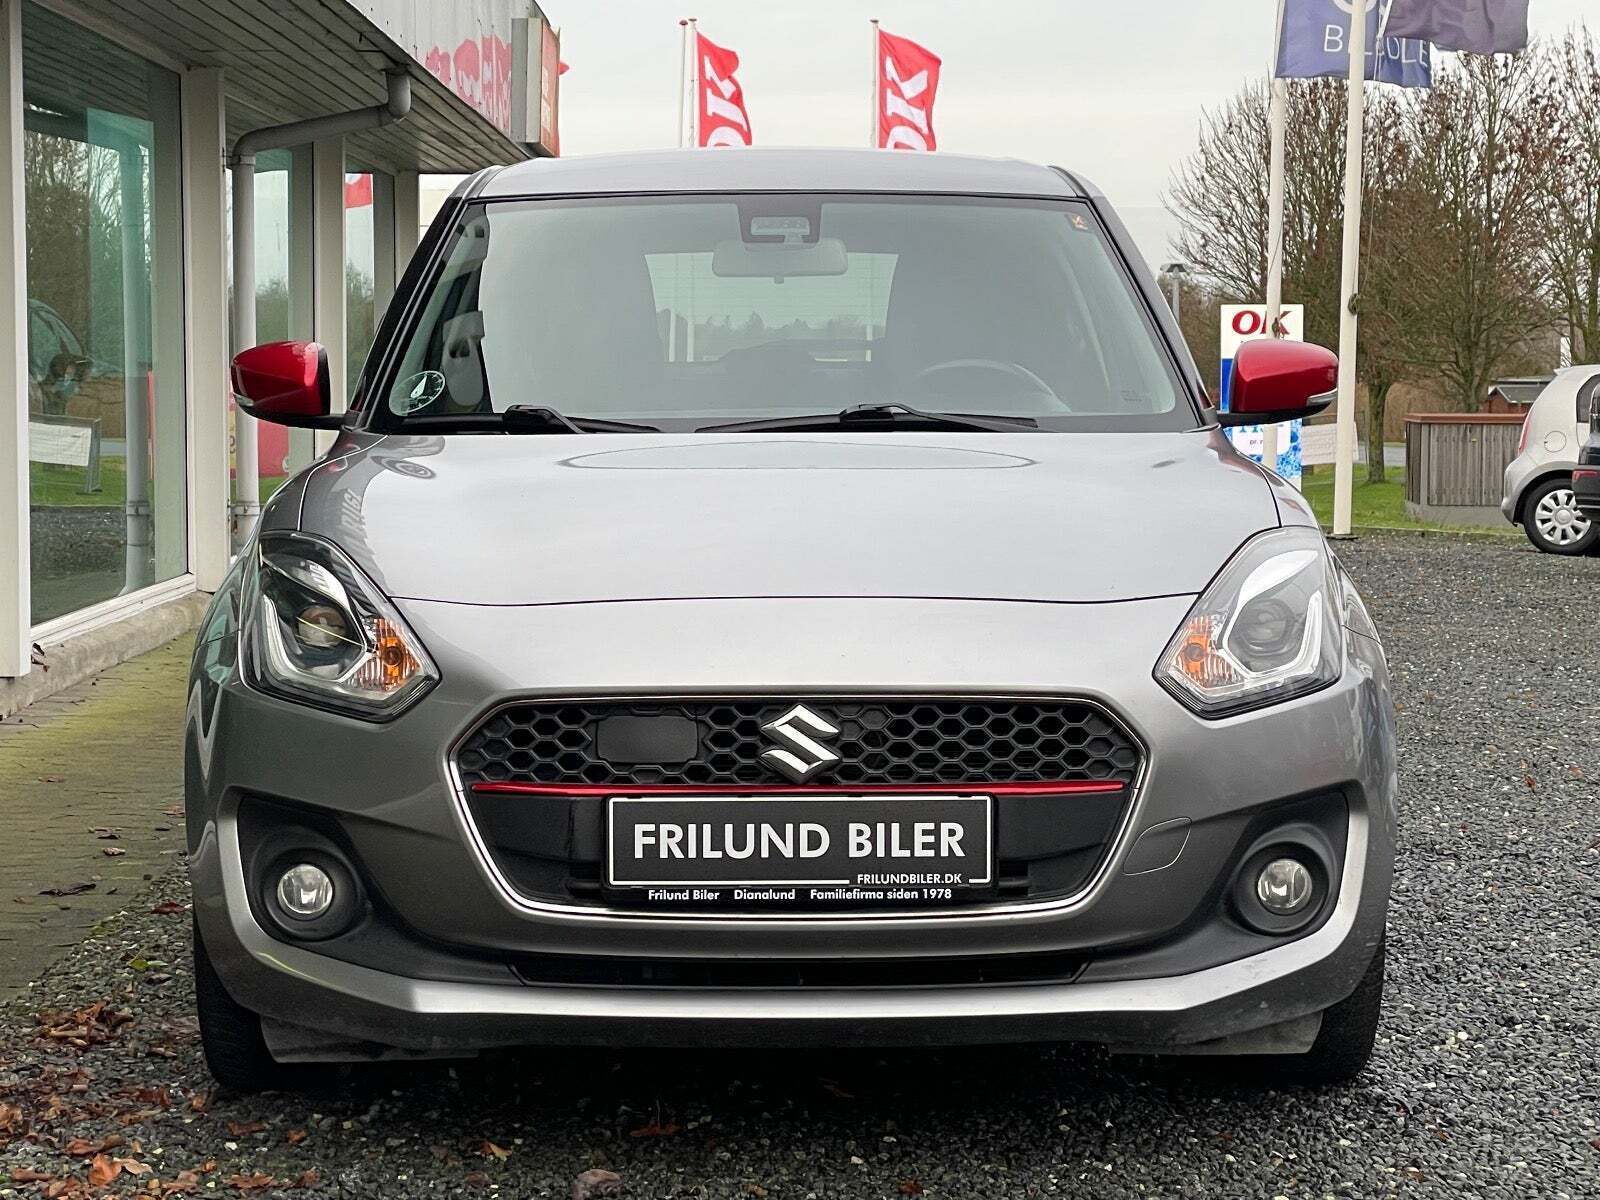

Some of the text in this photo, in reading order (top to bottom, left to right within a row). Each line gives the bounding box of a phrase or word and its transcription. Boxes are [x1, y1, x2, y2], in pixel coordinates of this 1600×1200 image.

[704, 54, 748, 146] K
[885, 55, 928, 151] K
[634, 822, 966, 858] FRILUND BILER
[857, 873, 962, 885] FRILUNDBILER.DK
[648, 889, 720, 901] Frilund Biler
[734, 888, 796, 900] Dianalund
[810, 888, 952, 900] Familiefirma siden 1978
